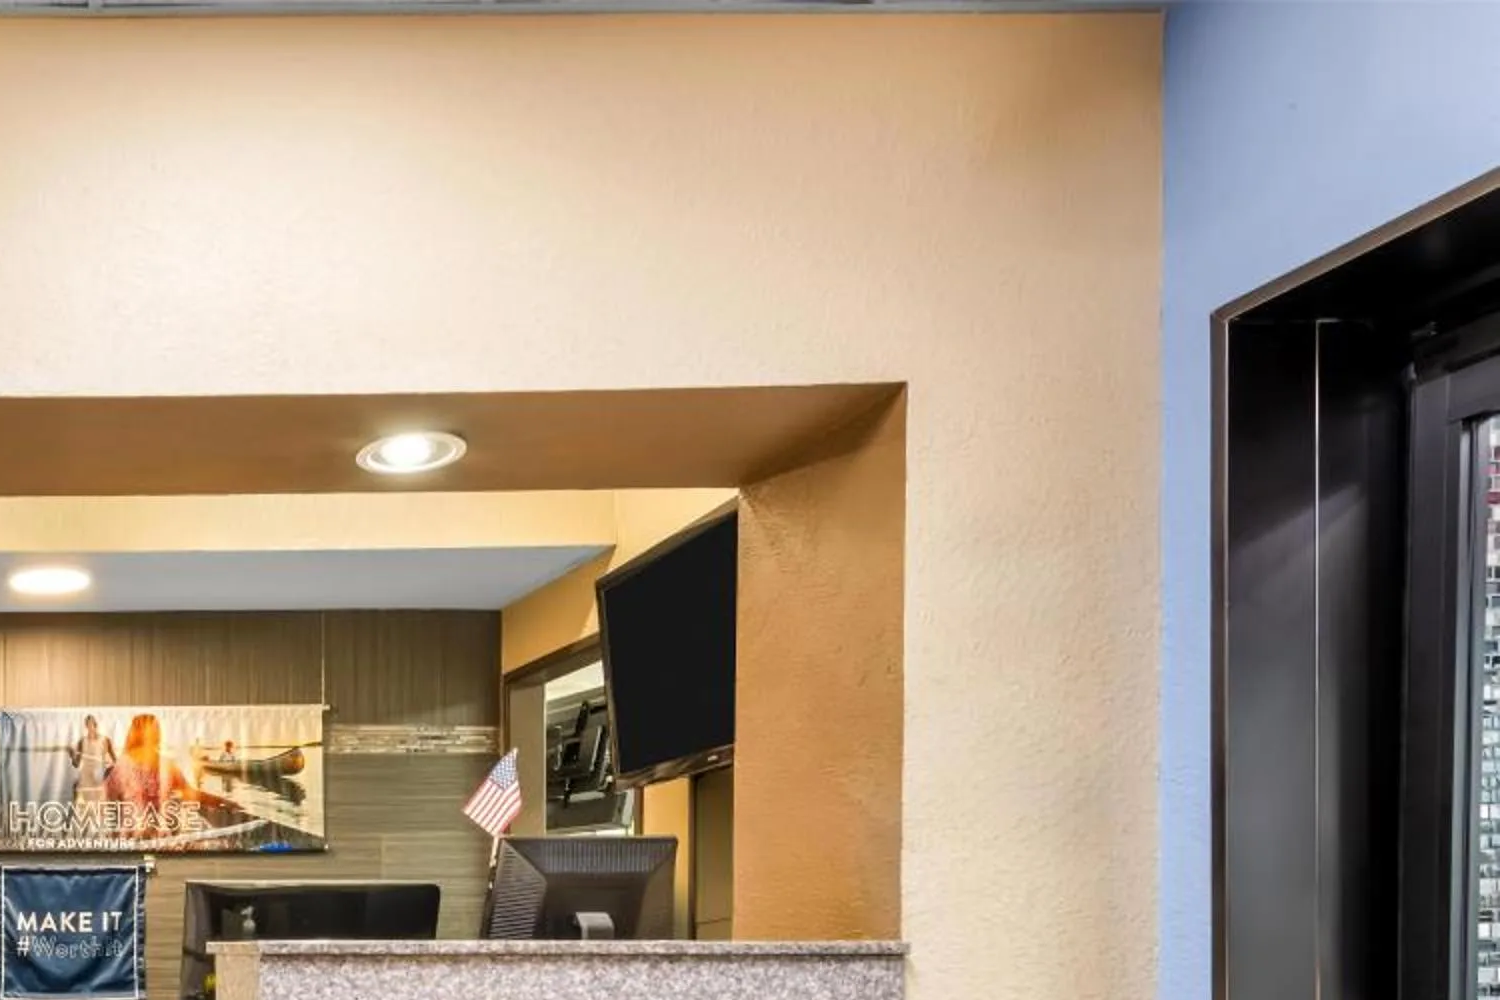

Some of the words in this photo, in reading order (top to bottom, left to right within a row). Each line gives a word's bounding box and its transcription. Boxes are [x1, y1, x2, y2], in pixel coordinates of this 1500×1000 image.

[10, 801, 202, 832] HOMEBASE
[27, 837, 55, 850] FOR
[17, 911, 93, 933] MAKE
[102, 911, 122, 932] IT
